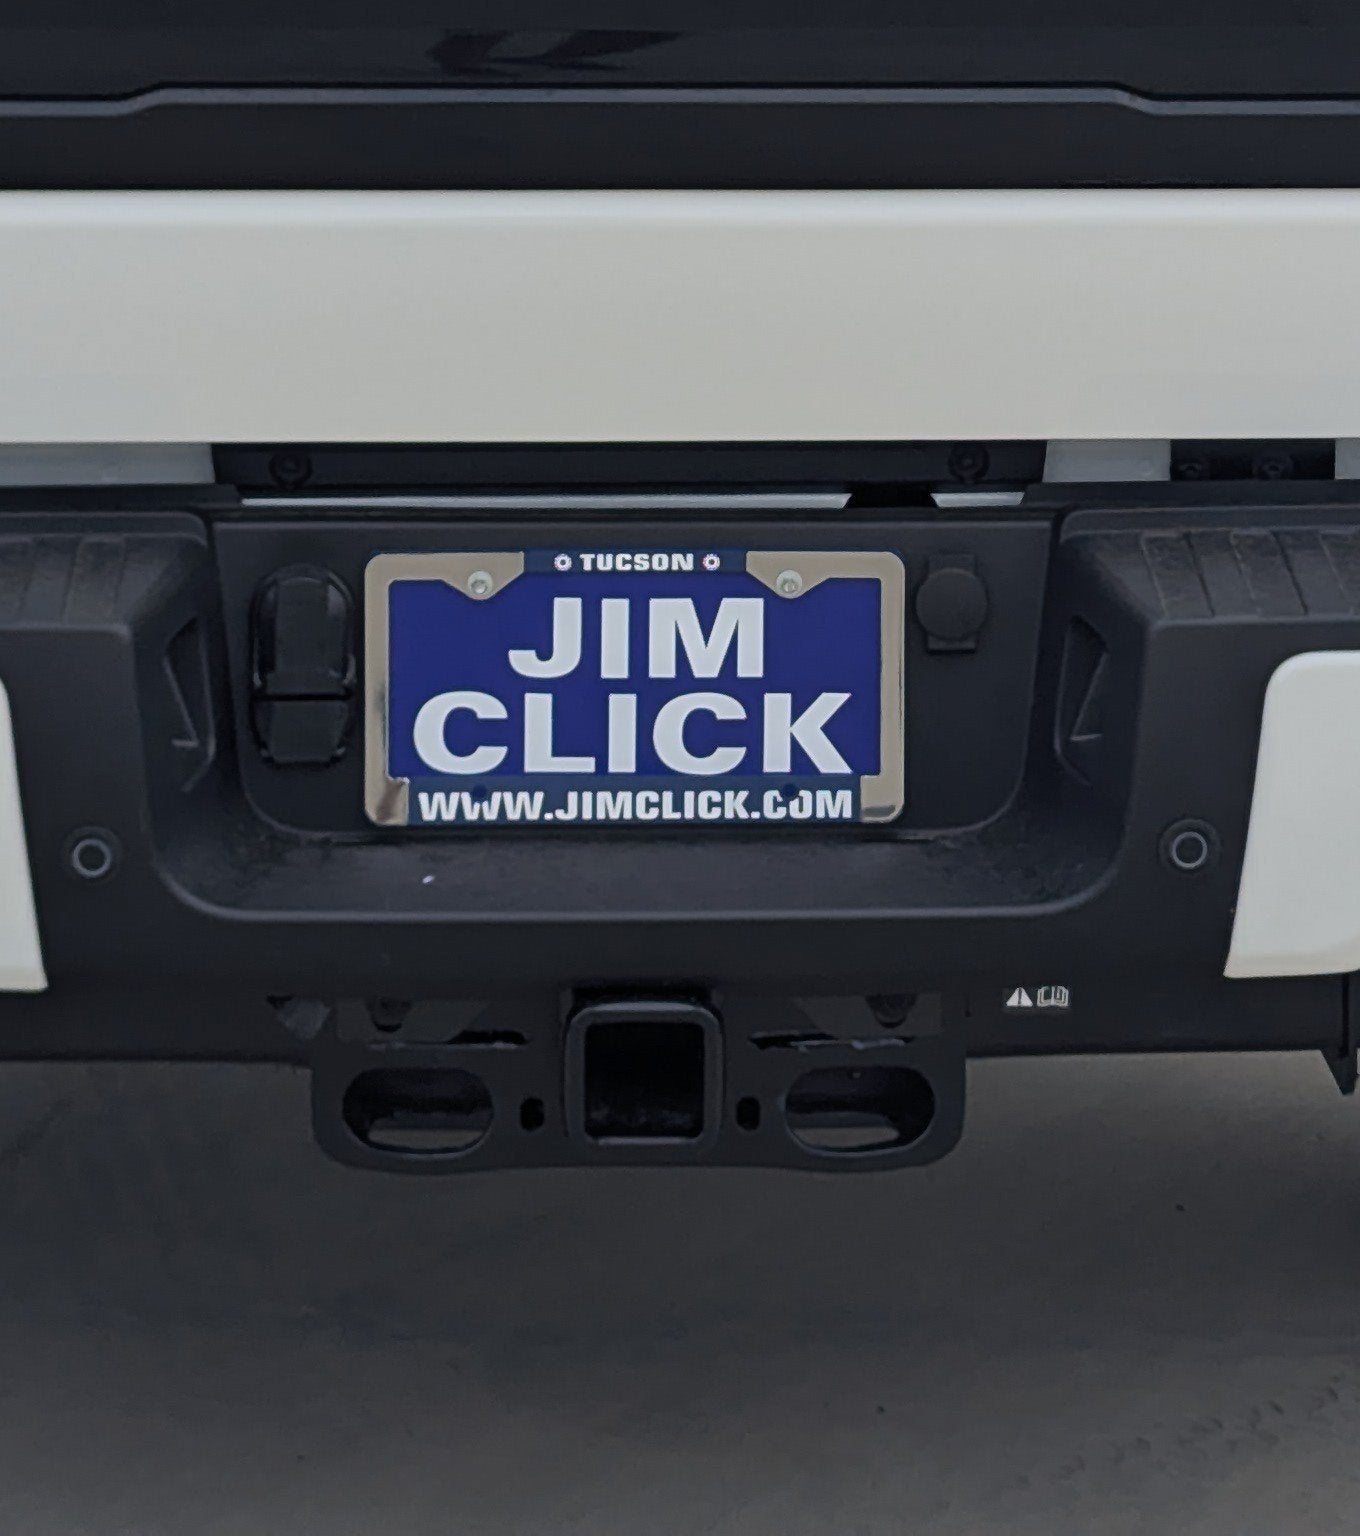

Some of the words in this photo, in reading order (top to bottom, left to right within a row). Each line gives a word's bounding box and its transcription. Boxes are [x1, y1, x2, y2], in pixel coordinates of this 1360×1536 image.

[579, 553, 694, 571] TUCSON
[507, 596, 766, 679] JIM
[412, 690, 853, 775] CLICK
[417, 789, 853, 821] WWW.JIMCLICK.COM
